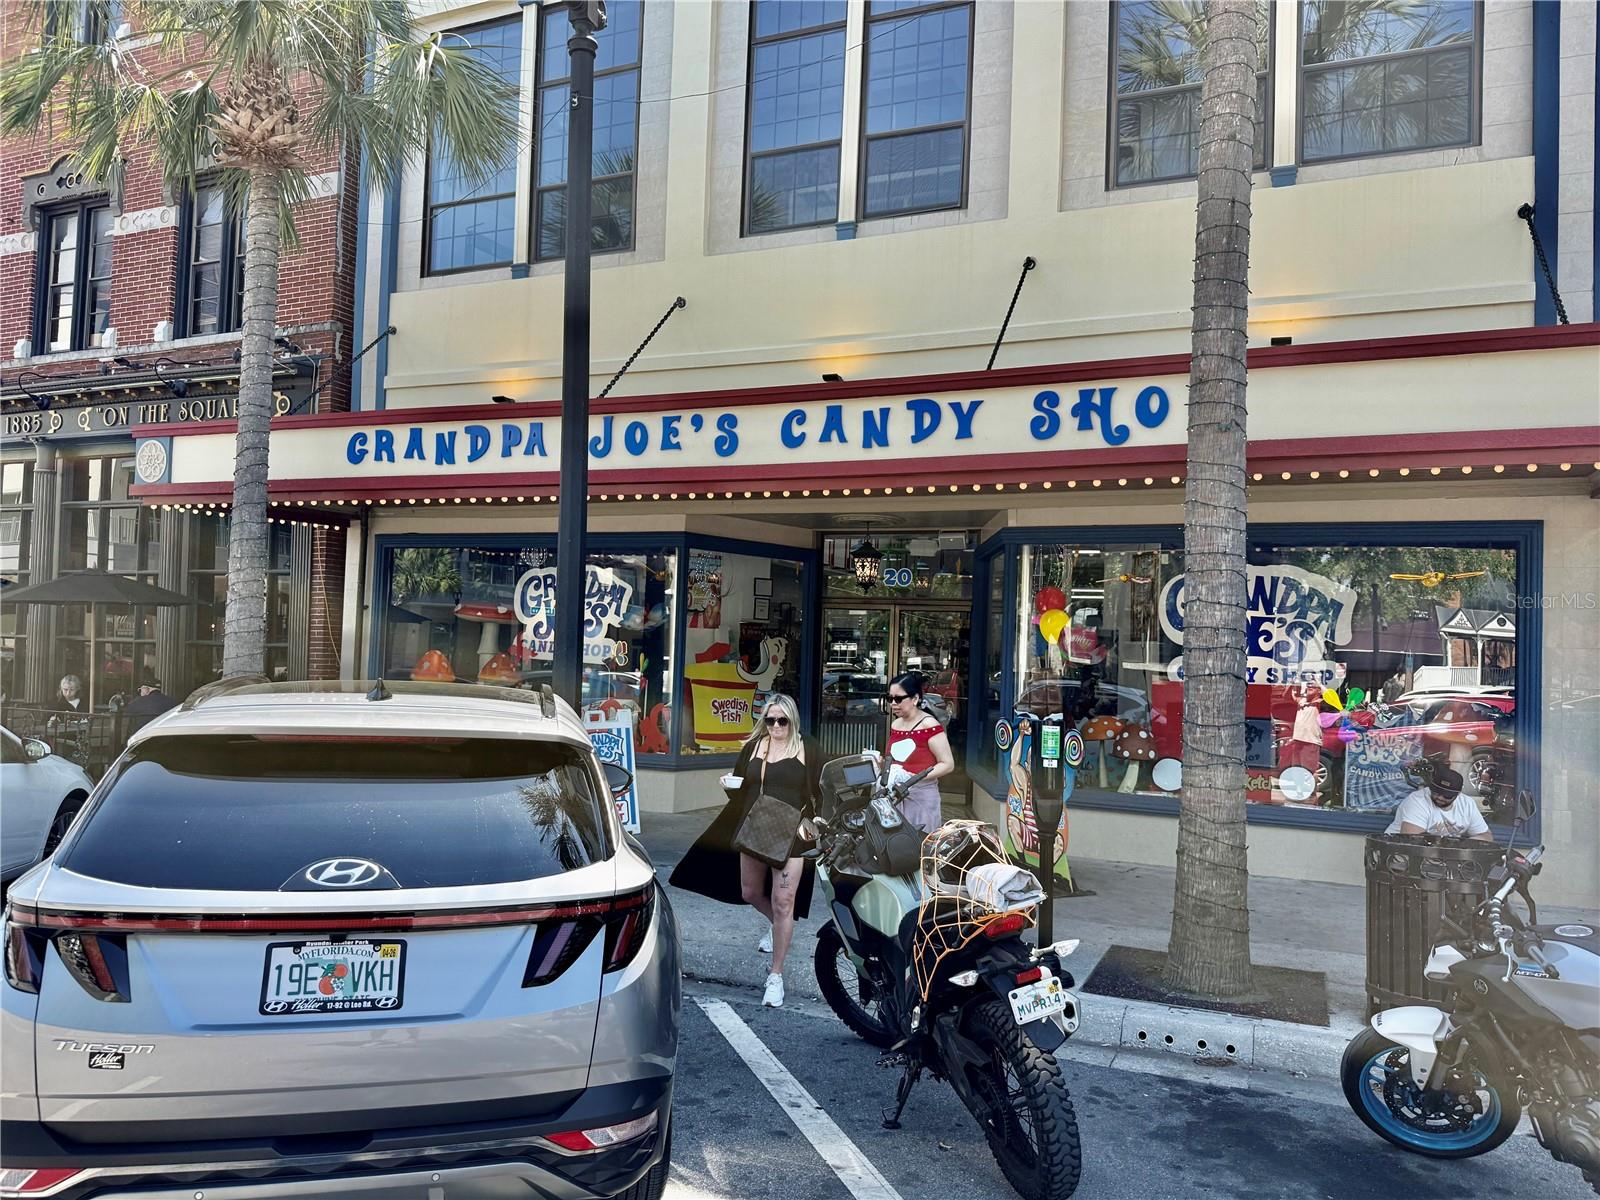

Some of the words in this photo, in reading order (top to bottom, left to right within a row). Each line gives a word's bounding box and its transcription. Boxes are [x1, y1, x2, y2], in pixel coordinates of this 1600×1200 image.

[138, 403, 169, 424] THE
[178, 398, 239, 422] SQUAR
[5, 414, 41, 434] 1885
[346, 422, 548, 466] GRANDPA
[588, 413, 739, 459] JOE'S
[780, 398, 984, 449] CANDY
[1030, 385, 1170, 446] SHO
[883, 567, 913, 587] 20
[583, 643, 612, 658] HOP
[711, 697, 749, 714] Swedish
[720, 709, 742, 723] Fish
[1350, 766, 1380, 779] CANDY
[1381, 771, 1403, 780] SHO
[298, 946, 374, 961] MYFLORIDA.COM
[275, 962, 319, 996] 19E
[351, 960, 394, 993] VKH
